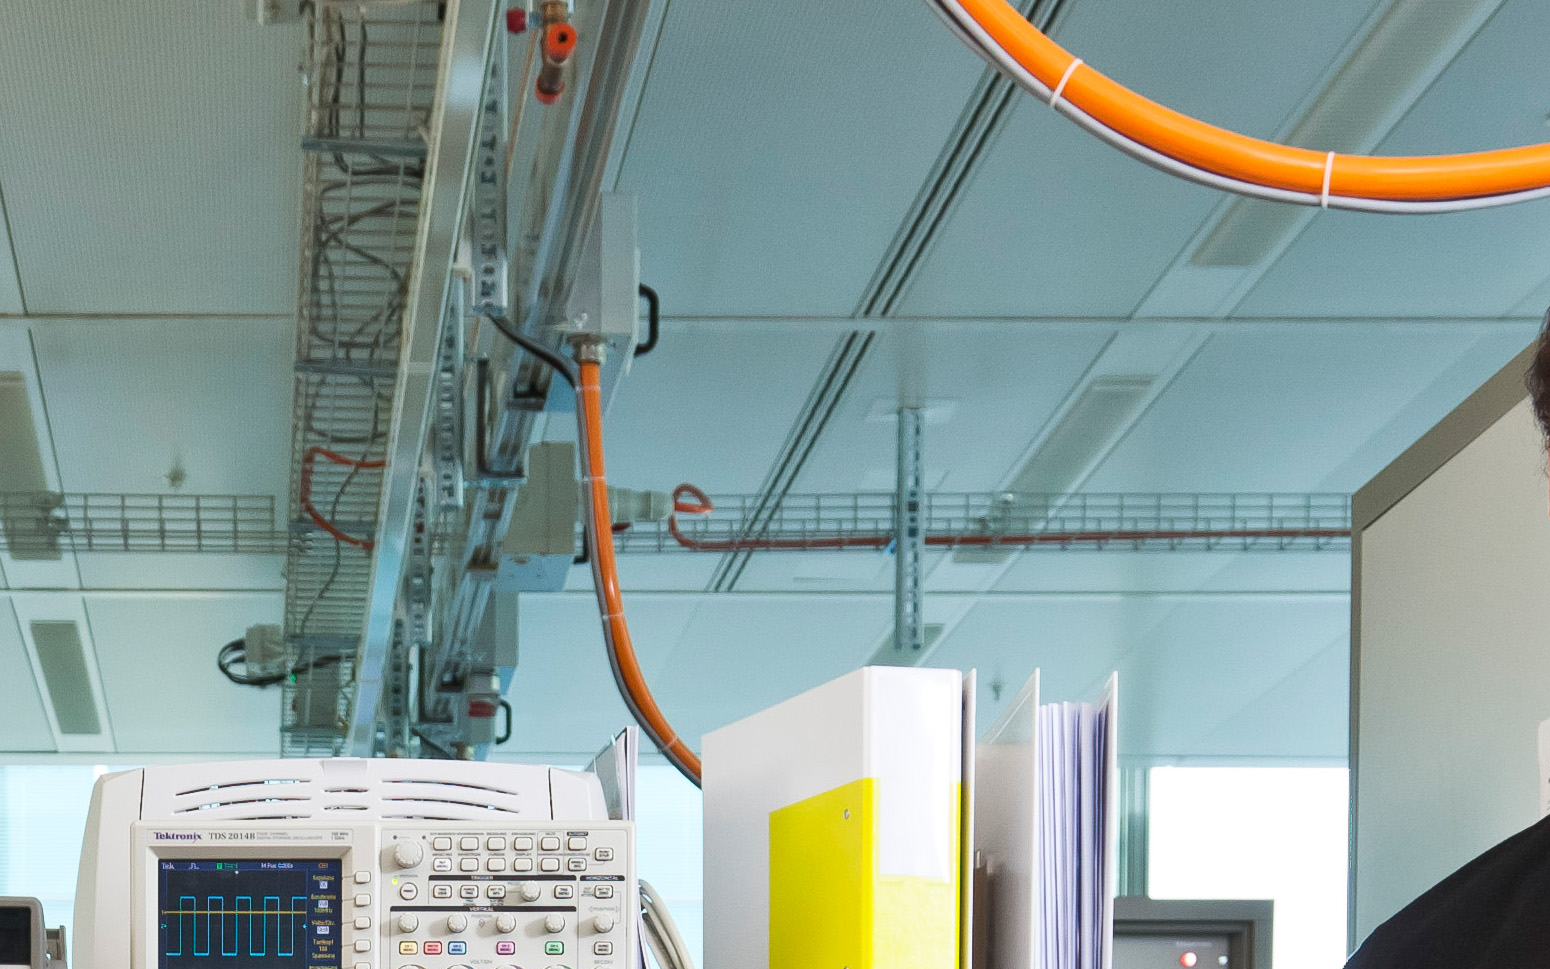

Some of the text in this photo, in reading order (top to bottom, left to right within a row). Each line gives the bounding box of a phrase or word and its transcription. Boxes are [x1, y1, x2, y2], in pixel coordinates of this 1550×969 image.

[154, 831, 202, 841] Tektronix
[209, 832, 226, 840] TDS
[228, 832, 256, 840] 2014B
